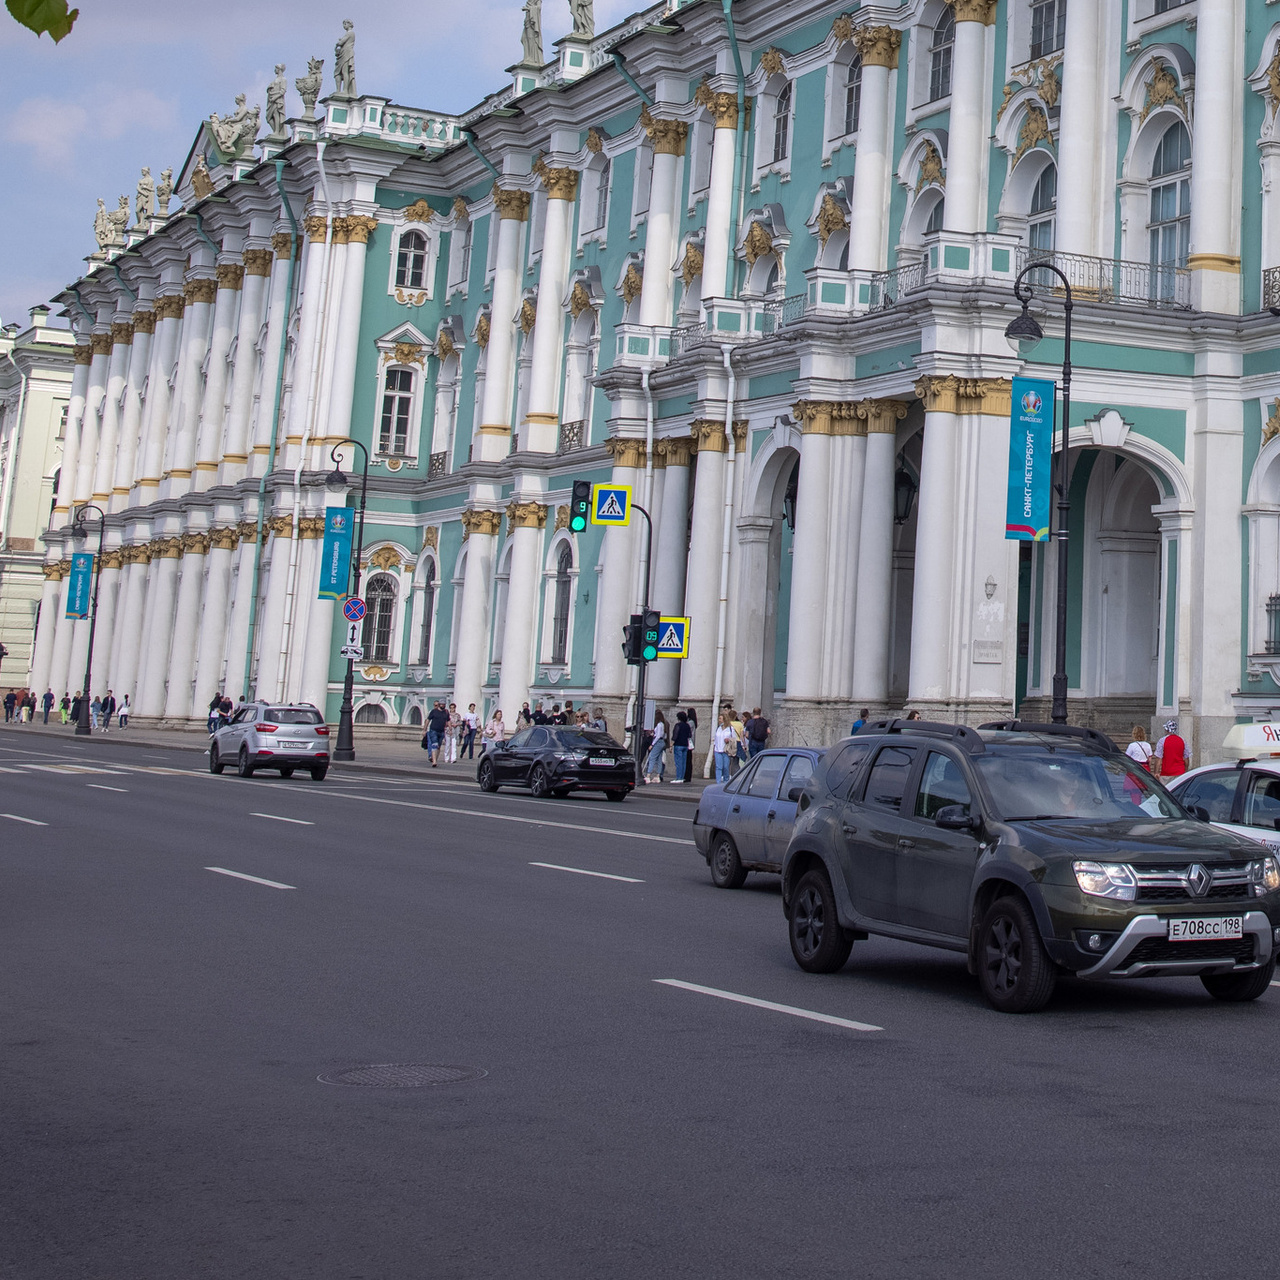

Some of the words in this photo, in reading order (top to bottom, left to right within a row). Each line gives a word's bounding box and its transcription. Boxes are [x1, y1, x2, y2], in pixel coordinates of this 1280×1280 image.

[1023, 430, 1035, 518] САНКТ-ПЕТЕРБУРГ
[646, 631, 658, 641] 09
[1172, 920, 1220, 936] Е708СС
[1222, 918, 1240, 930] 198
